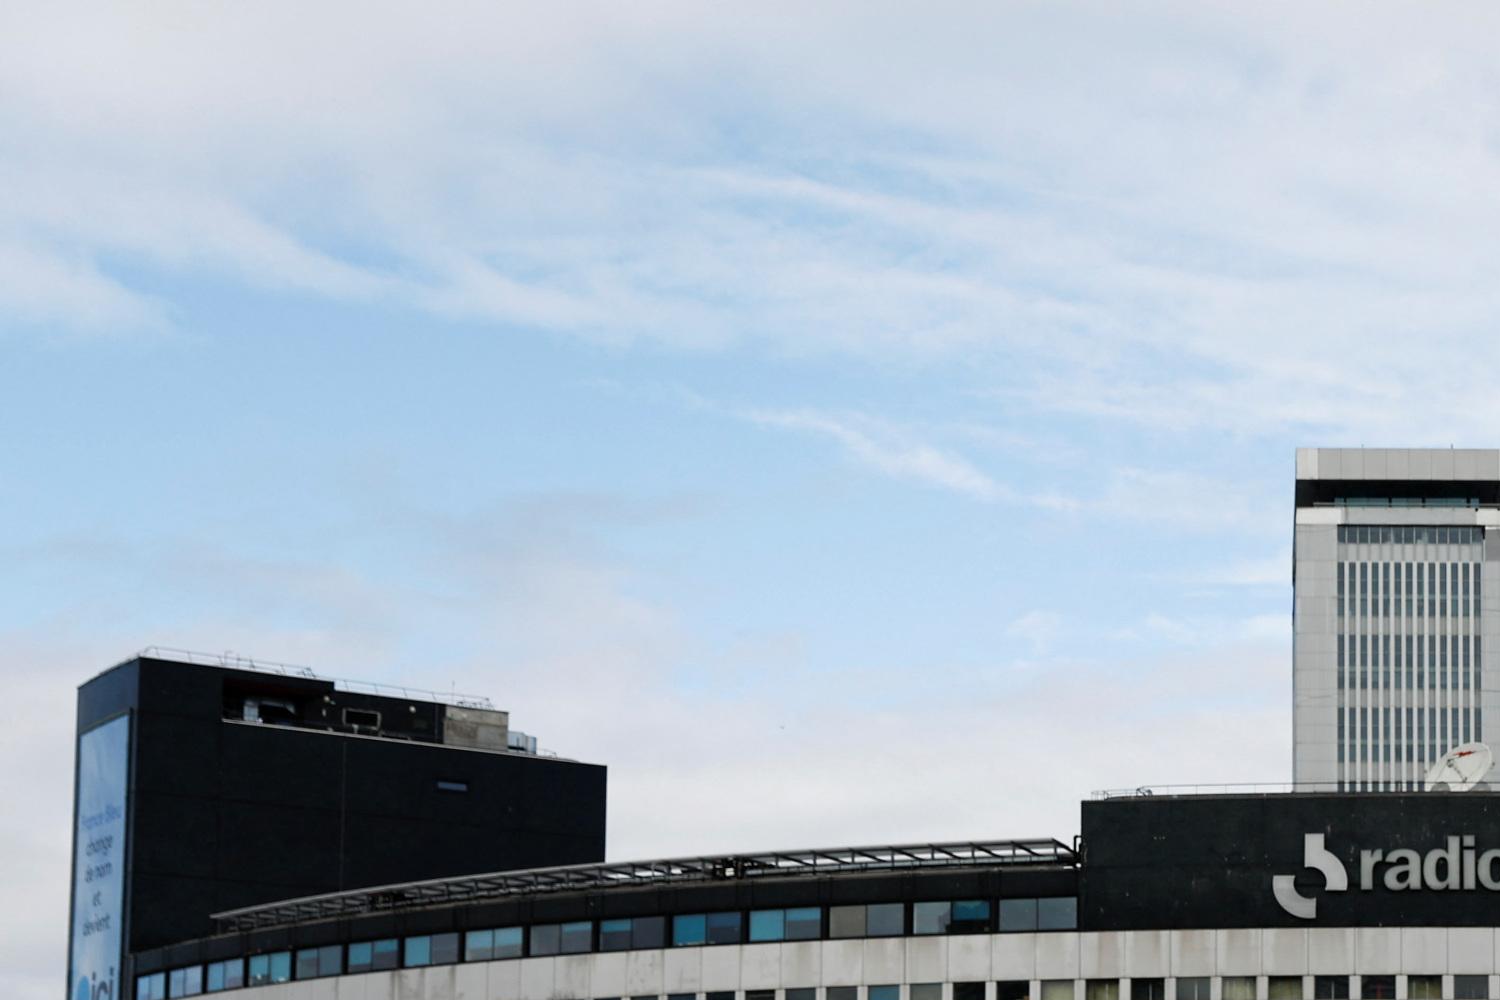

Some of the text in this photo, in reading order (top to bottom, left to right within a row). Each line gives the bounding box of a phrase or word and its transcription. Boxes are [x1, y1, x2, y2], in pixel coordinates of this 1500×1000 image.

[86, 834, 113, 857] change
[85, 862, 113, 884] de nom
[92, 890, 102, 907] et
[82, 912, 111, 937] devient
